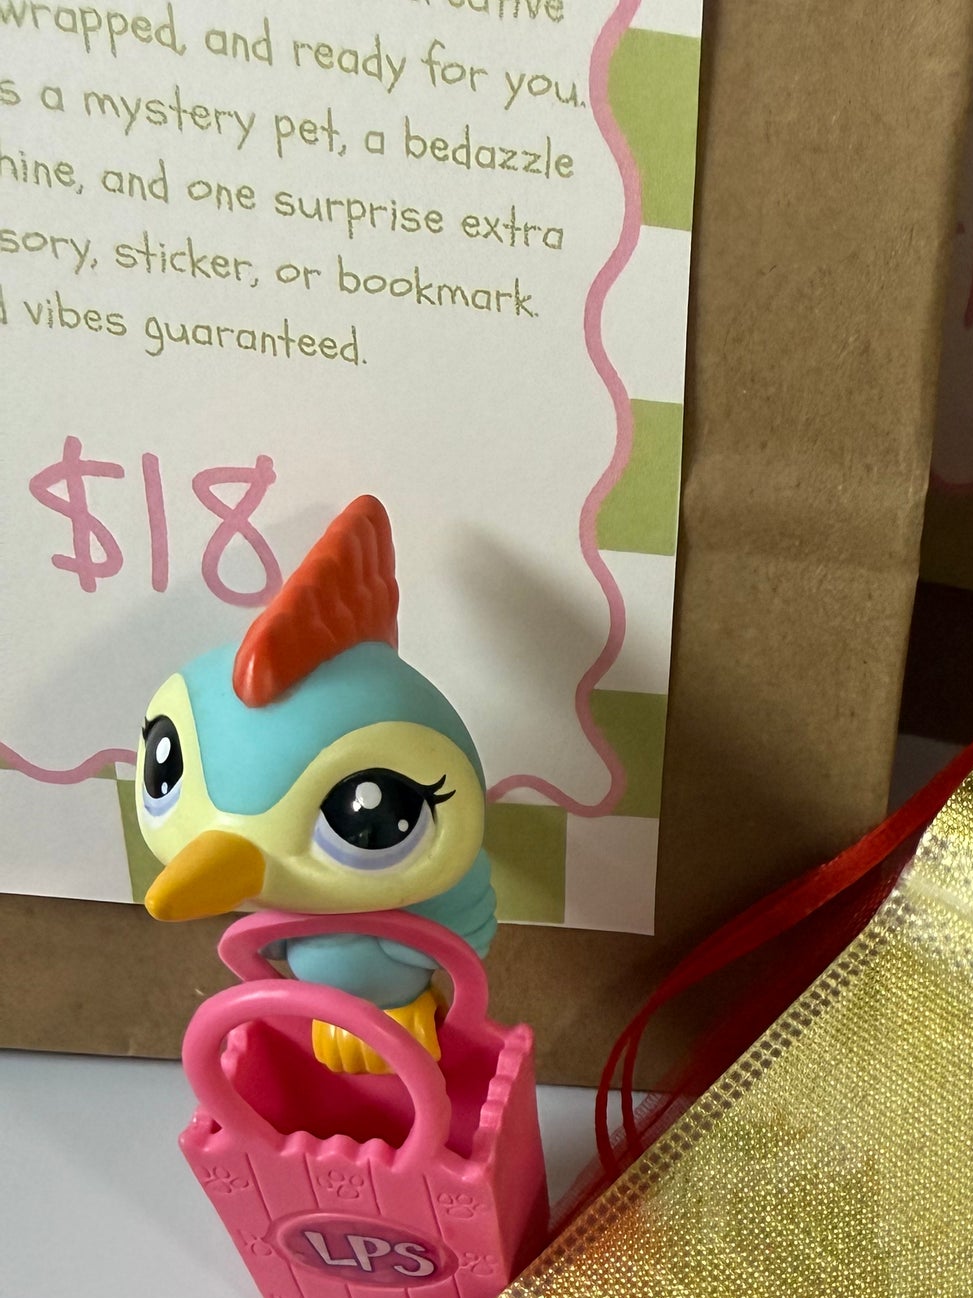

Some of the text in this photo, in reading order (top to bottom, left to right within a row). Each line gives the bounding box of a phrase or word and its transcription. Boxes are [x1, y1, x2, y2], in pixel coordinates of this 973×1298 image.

[205, 17, 273, 66] and
[293, 33, 406, 94] ready
[421, 39, 488, 92] for
[505, 72, 586, 110] you.
[41, 86, 64, 112] a
[84, 84, 256, 150] mystery
[275, 107, 347, 158] pet,
[365, 130, 385, 155] a
[405, 115, 574, 179] bedazzle
[102, 159, 168, 203] and
[187, 179, 256, 212] one
[274, 191, 444, 240] surprise
[461, 204, 564, 250] extra
[115, 231, 259, 287] sticker,
[276, 263, 322, 290] or
[338, 254, 539, 318] bookmark.
[24, 291, 128, 336] vibes
[145, 316, 368, 366] guaranteed.
[29, 436, 285, 608] $18
[304, 1231, 435, 1277] LPS
